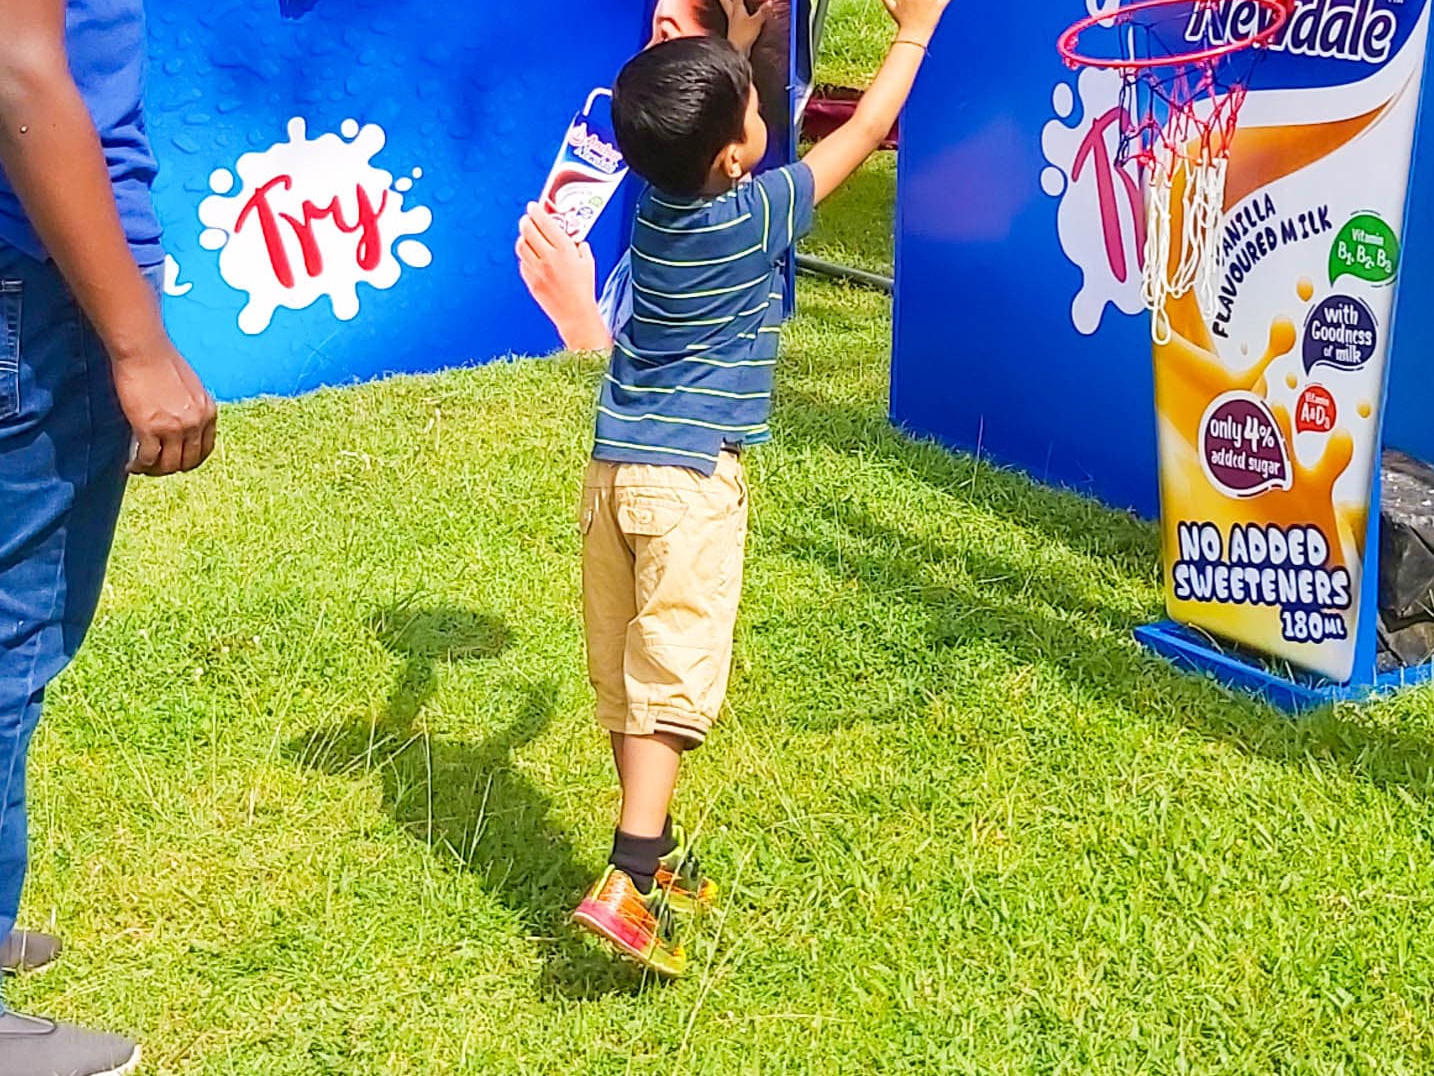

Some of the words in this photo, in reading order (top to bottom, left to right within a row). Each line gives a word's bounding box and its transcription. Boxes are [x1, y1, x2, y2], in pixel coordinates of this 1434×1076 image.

[234, 174, 388, 290] Try
[1351, 228, 1385, 246] Vitamin
[1212, 230, 1278, 338] FLAVOURED
[1281, 204, 1332, 244] MILK
[1324, 304, 1358, 324] with
[1311, 320, 1372, 346] Goodness
[1323, 345, 1332, 358] of
[1335, 345, 1362, 363] milk
[1210, 417, 1242, 448] only
[1243, 416, 1275, 452] 4%
[1210, 447, 1246, 470] added
[1248, 453, 1281, 478] sugar
[1179, 524, 1222, 561] NO
[1229, 526, 1328, 566] ADDED
[1174, 564, 1349, 606] SWEETENERS
